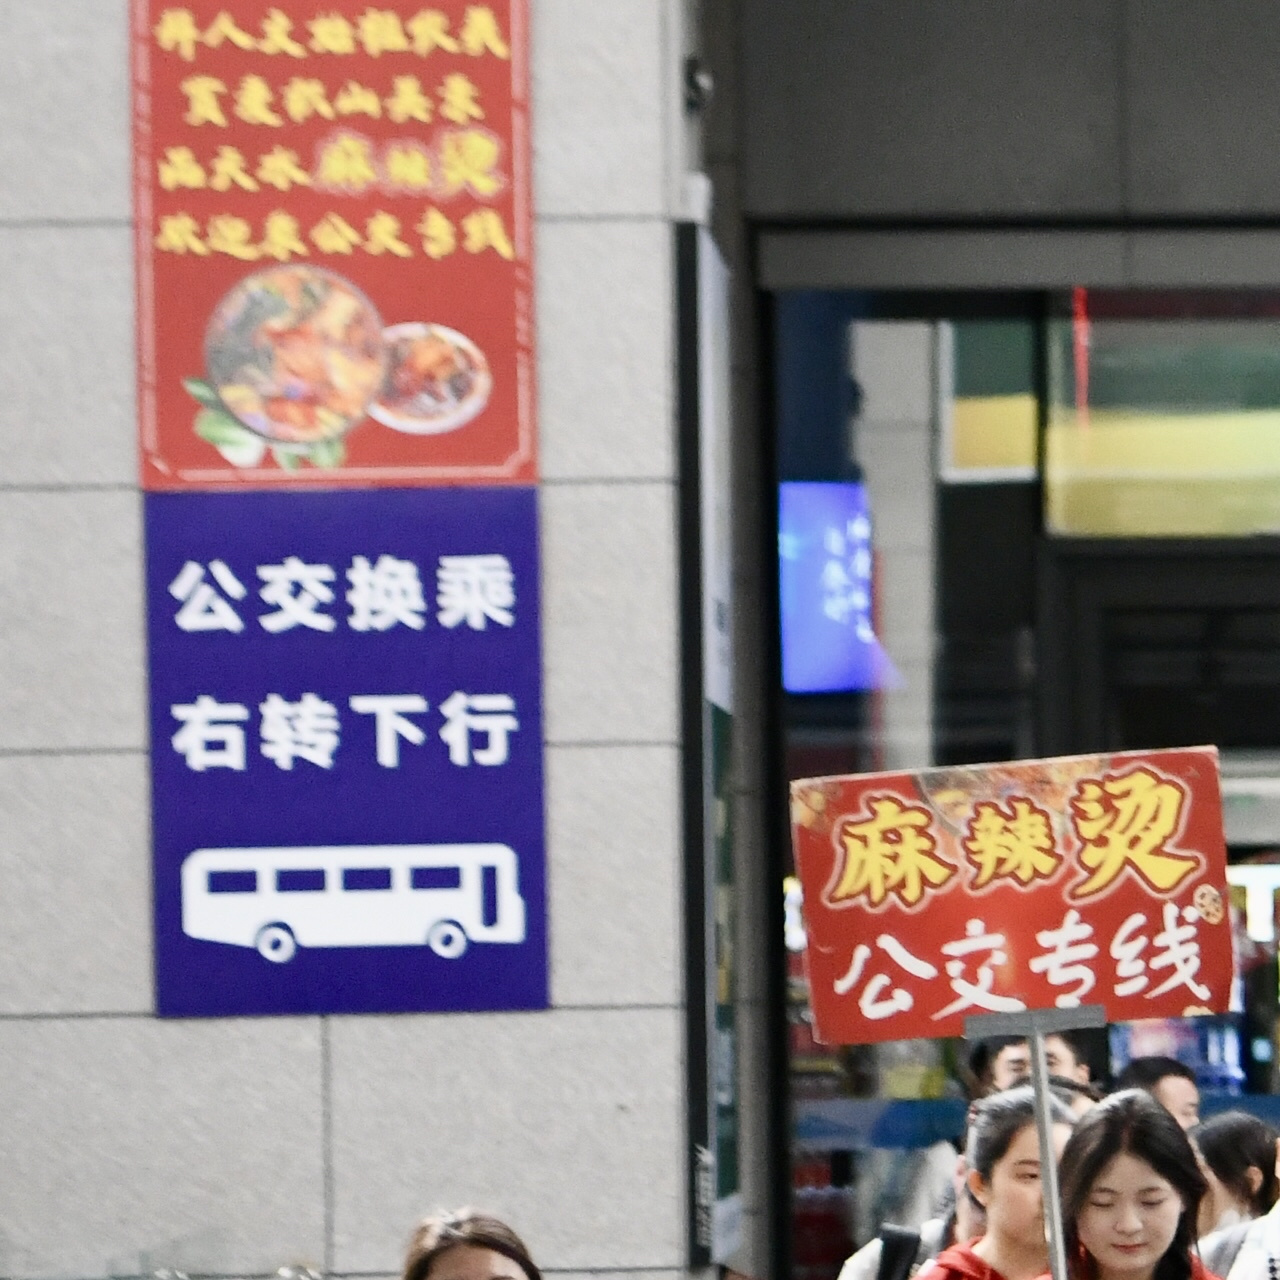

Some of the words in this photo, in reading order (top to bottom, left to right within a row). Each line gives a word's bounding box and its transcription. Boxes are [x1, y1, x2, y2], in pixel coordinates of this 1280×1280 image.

[159, 129, 504, 198] 品天水麻辣烫
[168, 555, 515, 633] 公交换乘
[170, 692, 518, 771] 右转下行
[829, 765, 1202, 908] 麻辣烫
[834, 901, 1211, 1020] 公交专线
